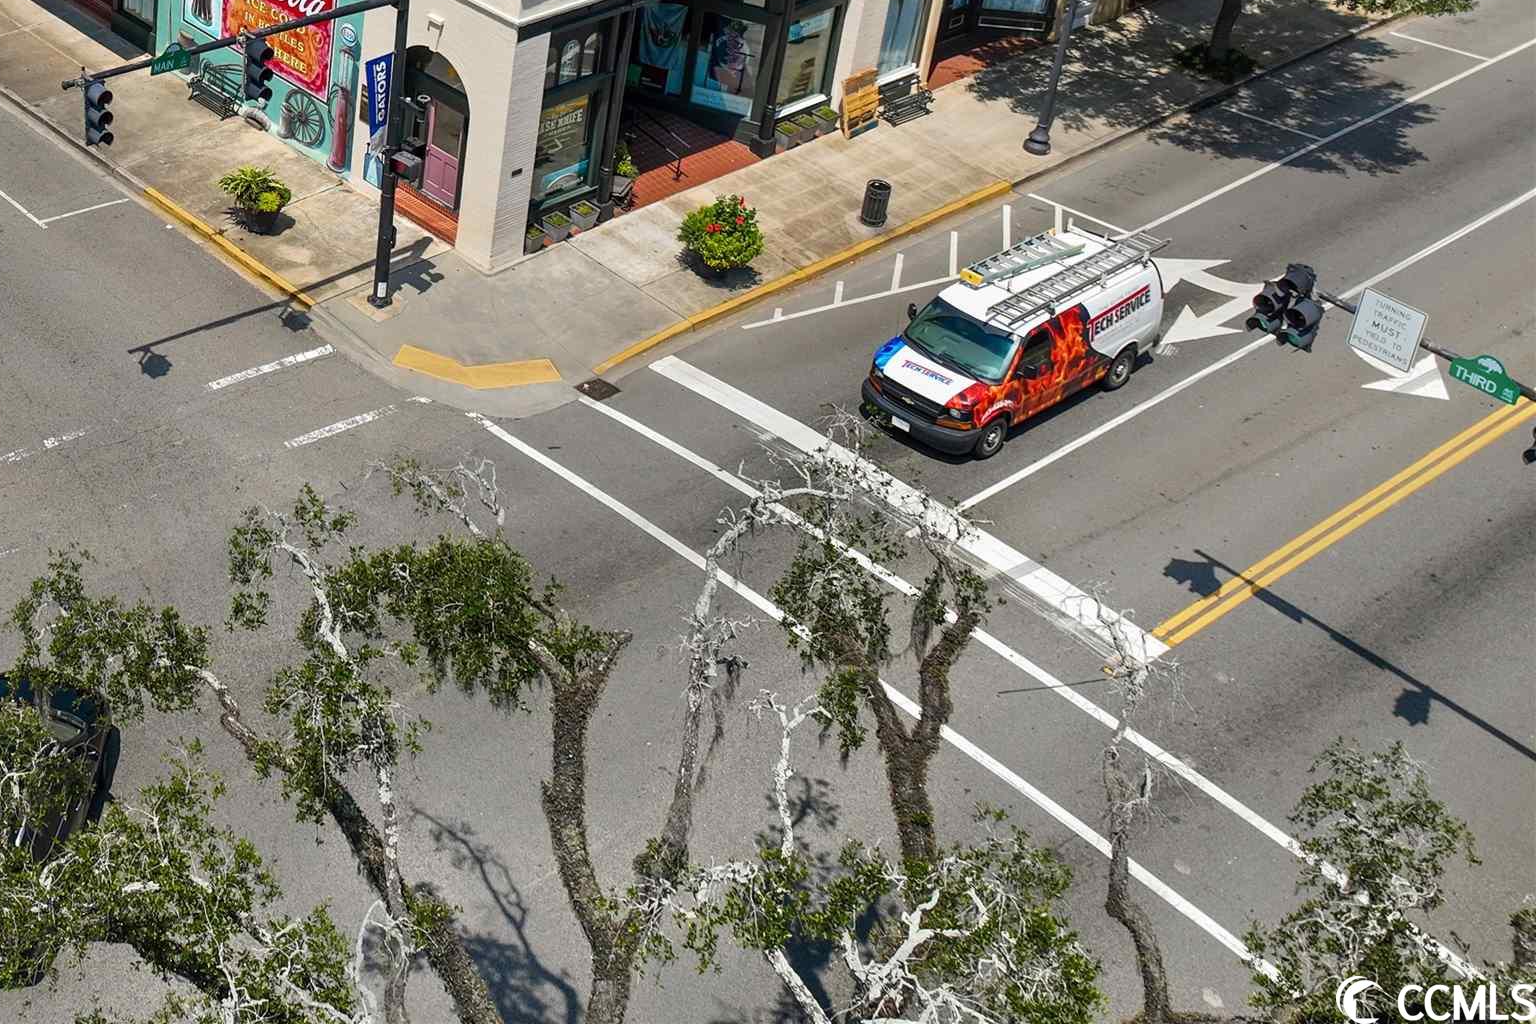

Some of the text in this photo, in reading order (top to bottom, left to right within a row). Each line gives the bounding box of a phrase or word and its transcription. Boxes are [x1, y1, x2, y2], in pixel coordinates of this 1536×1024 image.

[245, 11, 255, 23] IN
[153, 60, 174, 73] MAIN
[274, 46, 308, 74] HERE
[375, 61, 387, 121] GATORS
[1088, 289, 1152, 342] TECH SERVICE
[1375, 299, 1413, 321] TURNING
[1371, 320, 1401, 339] MUST
[1352, 333, 1409, 366] PEDESTRIANS
[1392, 342, 1402, 352] TO
[1455, 364, 1498, 394] THIRD
